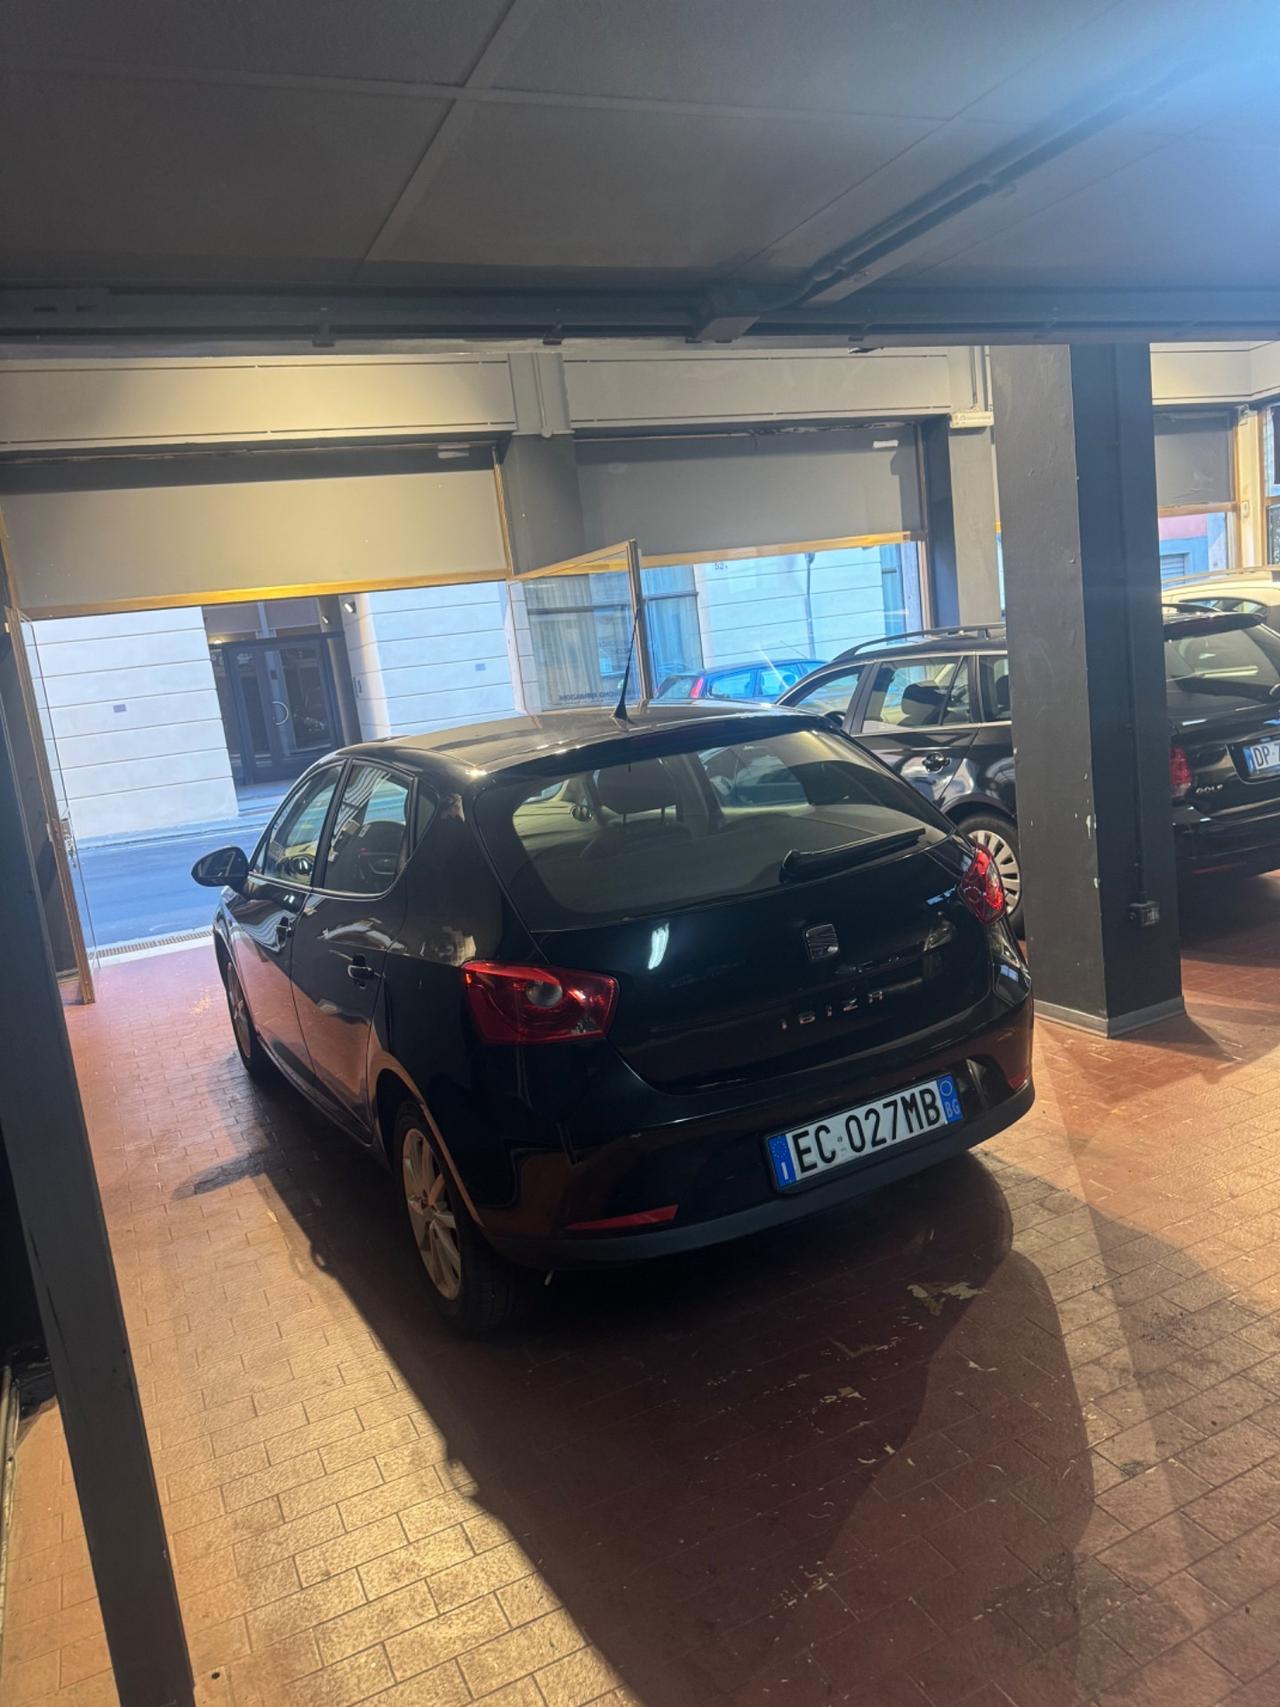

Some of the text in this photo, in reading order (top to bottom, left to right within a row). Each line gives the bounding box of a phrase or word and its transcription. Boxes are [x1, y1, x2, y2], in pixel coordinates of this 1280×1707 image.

[1253, 745, 1271, 767] DP
[780, 989, 885, 1030] IBIZA
[944, 1098, 961, 1118] BG
